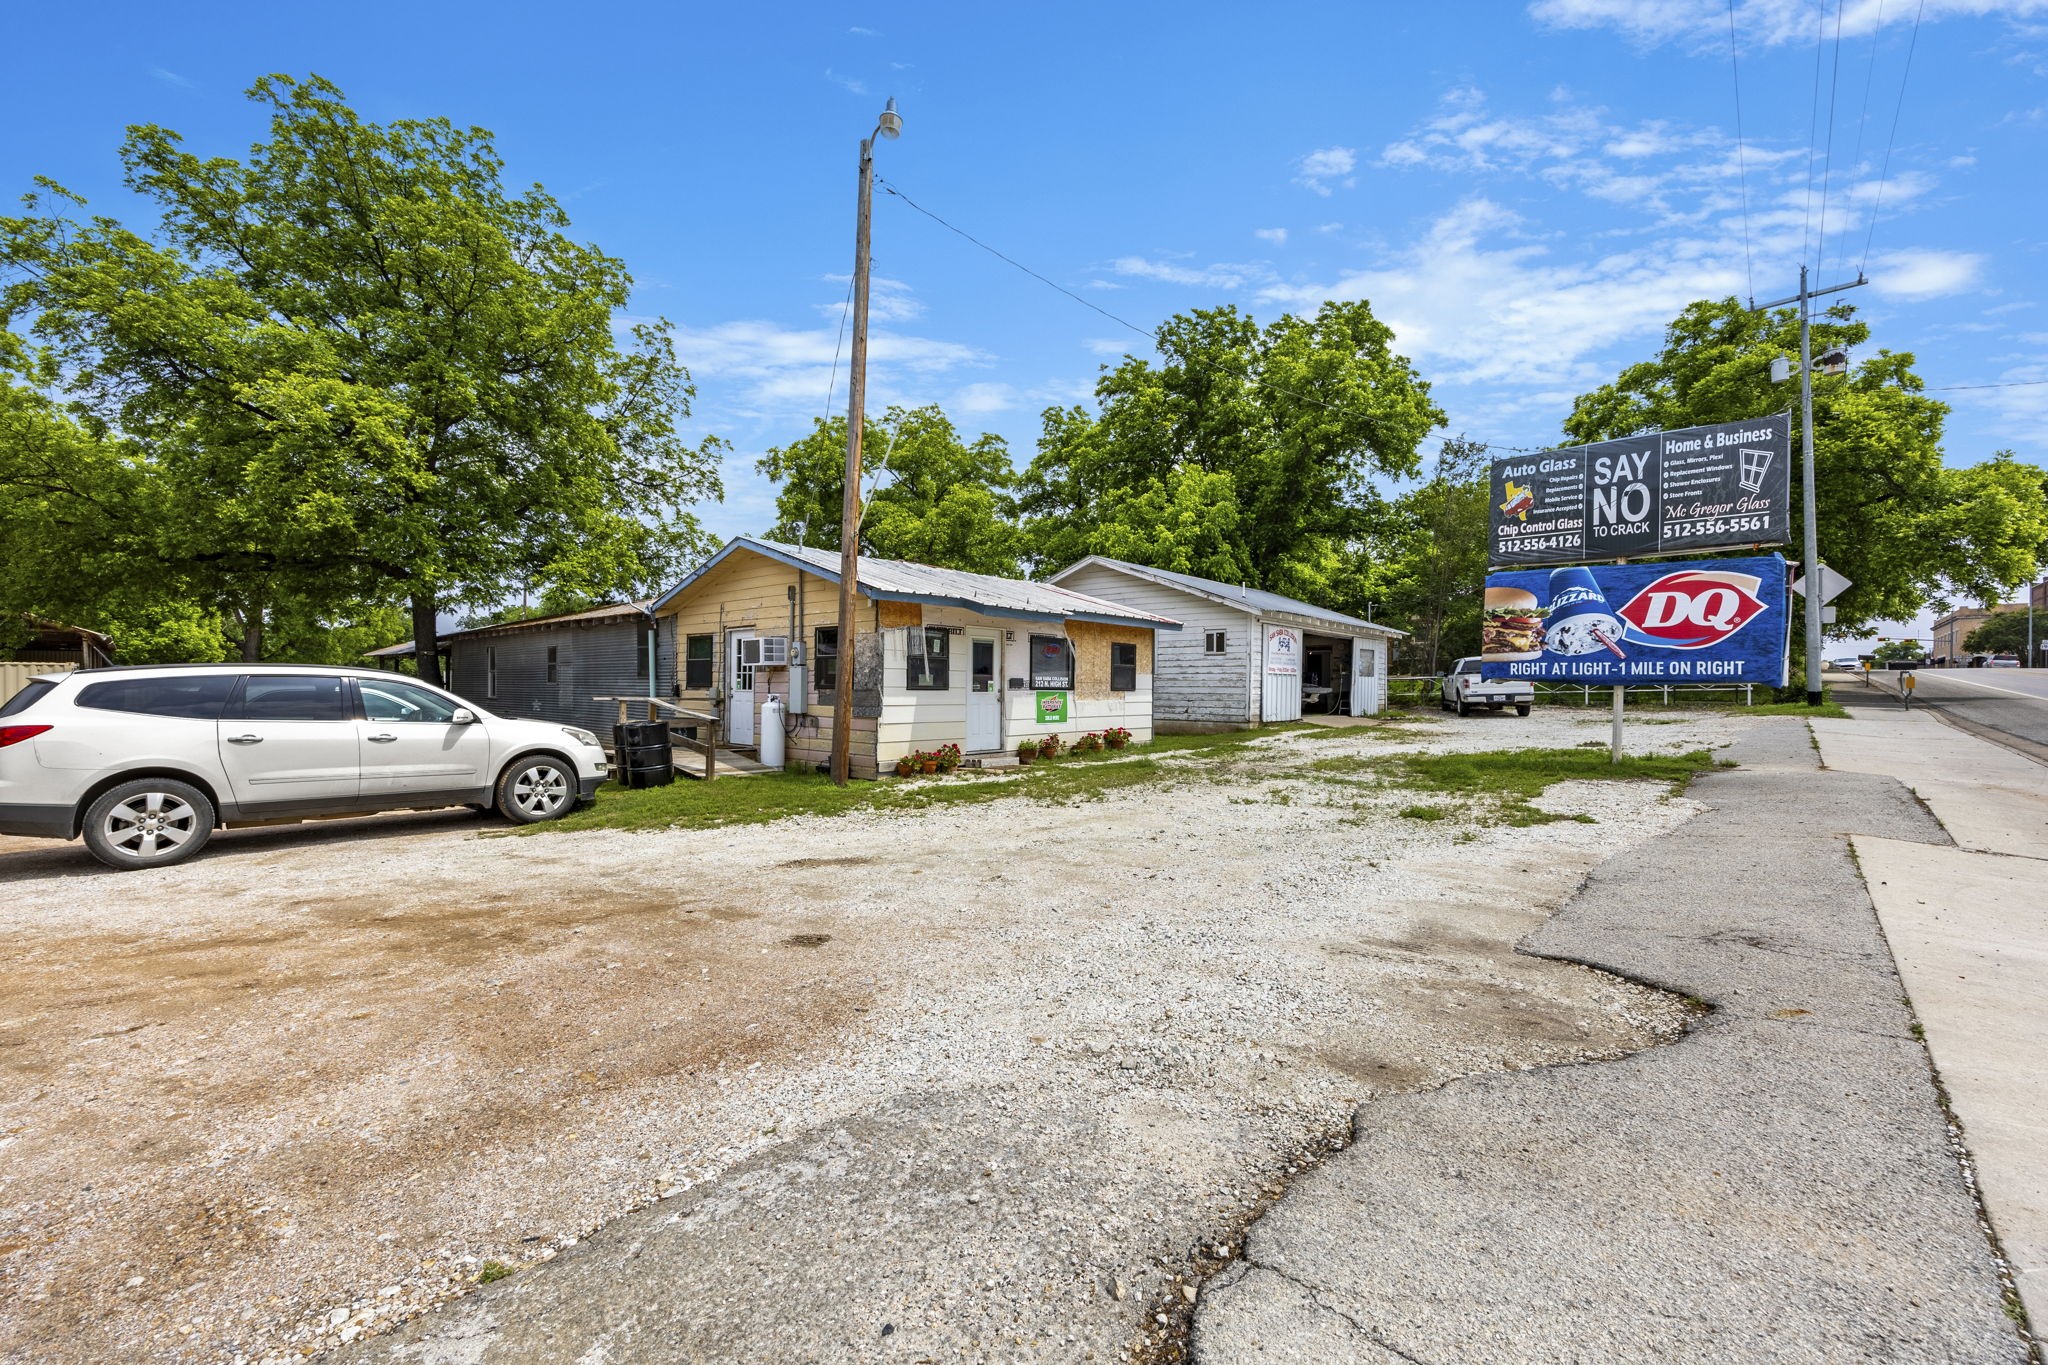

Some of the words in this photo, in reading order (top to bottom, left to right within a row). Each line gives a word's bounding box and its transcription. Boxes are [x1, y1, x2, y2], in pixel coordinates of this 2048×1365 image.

[1665, 439, 1702, 455] Home
[1703, 434, 1714, 449] &
[1716, 428, 1773, 447] Business
[1501, 464, 1536, 479] Auto
[1539, 458, 1577, 473] Glass
[1594, 450, 1651, 485] SAY
[1687, 456, 1709, 464] Mirrors,
[1561, 475, 1578, 483] Repairs
[1670, 467, 1706, 477] Replacement
[1706, 464, 1733, 473] Windows
[1545, 485, 1578, 494] Replacements
[1691, 477, 1721, 486] Enclosures
[1684, 490, 1703, 498] Fronts
[1555, 504, 1578, 512] Accepted
[1593, 482, 1651, 526] NO
[1665, 504, 1687, 519] Mc
[1689, 502, 1734, 521] Gregor
[1736, 493, 1771, 513] Glass
[1498, 524, 1519, 538] Chip
[1520, 519, 1556, 534] Control
[1557, 518, 1583, 530] Glass
[1593, 526, 1608, 537] TO
[1610, 521, 1650, 536] CRACK
[1663, 515, 1770, 539] 512-556-5561
[1498, 534, 1582, 554] 512-556-4126
[1642, 587, 1742, 631] DQ
[1510, 662, 1548, 676] RIGHT
[1551, 662, 1568, 676] AT
[1572, 662, 1626, 675] LIGHT-1
[1631, 662, 1664, 675] MILE
[1669, 661, 1691, 675] ON
[1696, 660, 1745, 675] RIGHT
